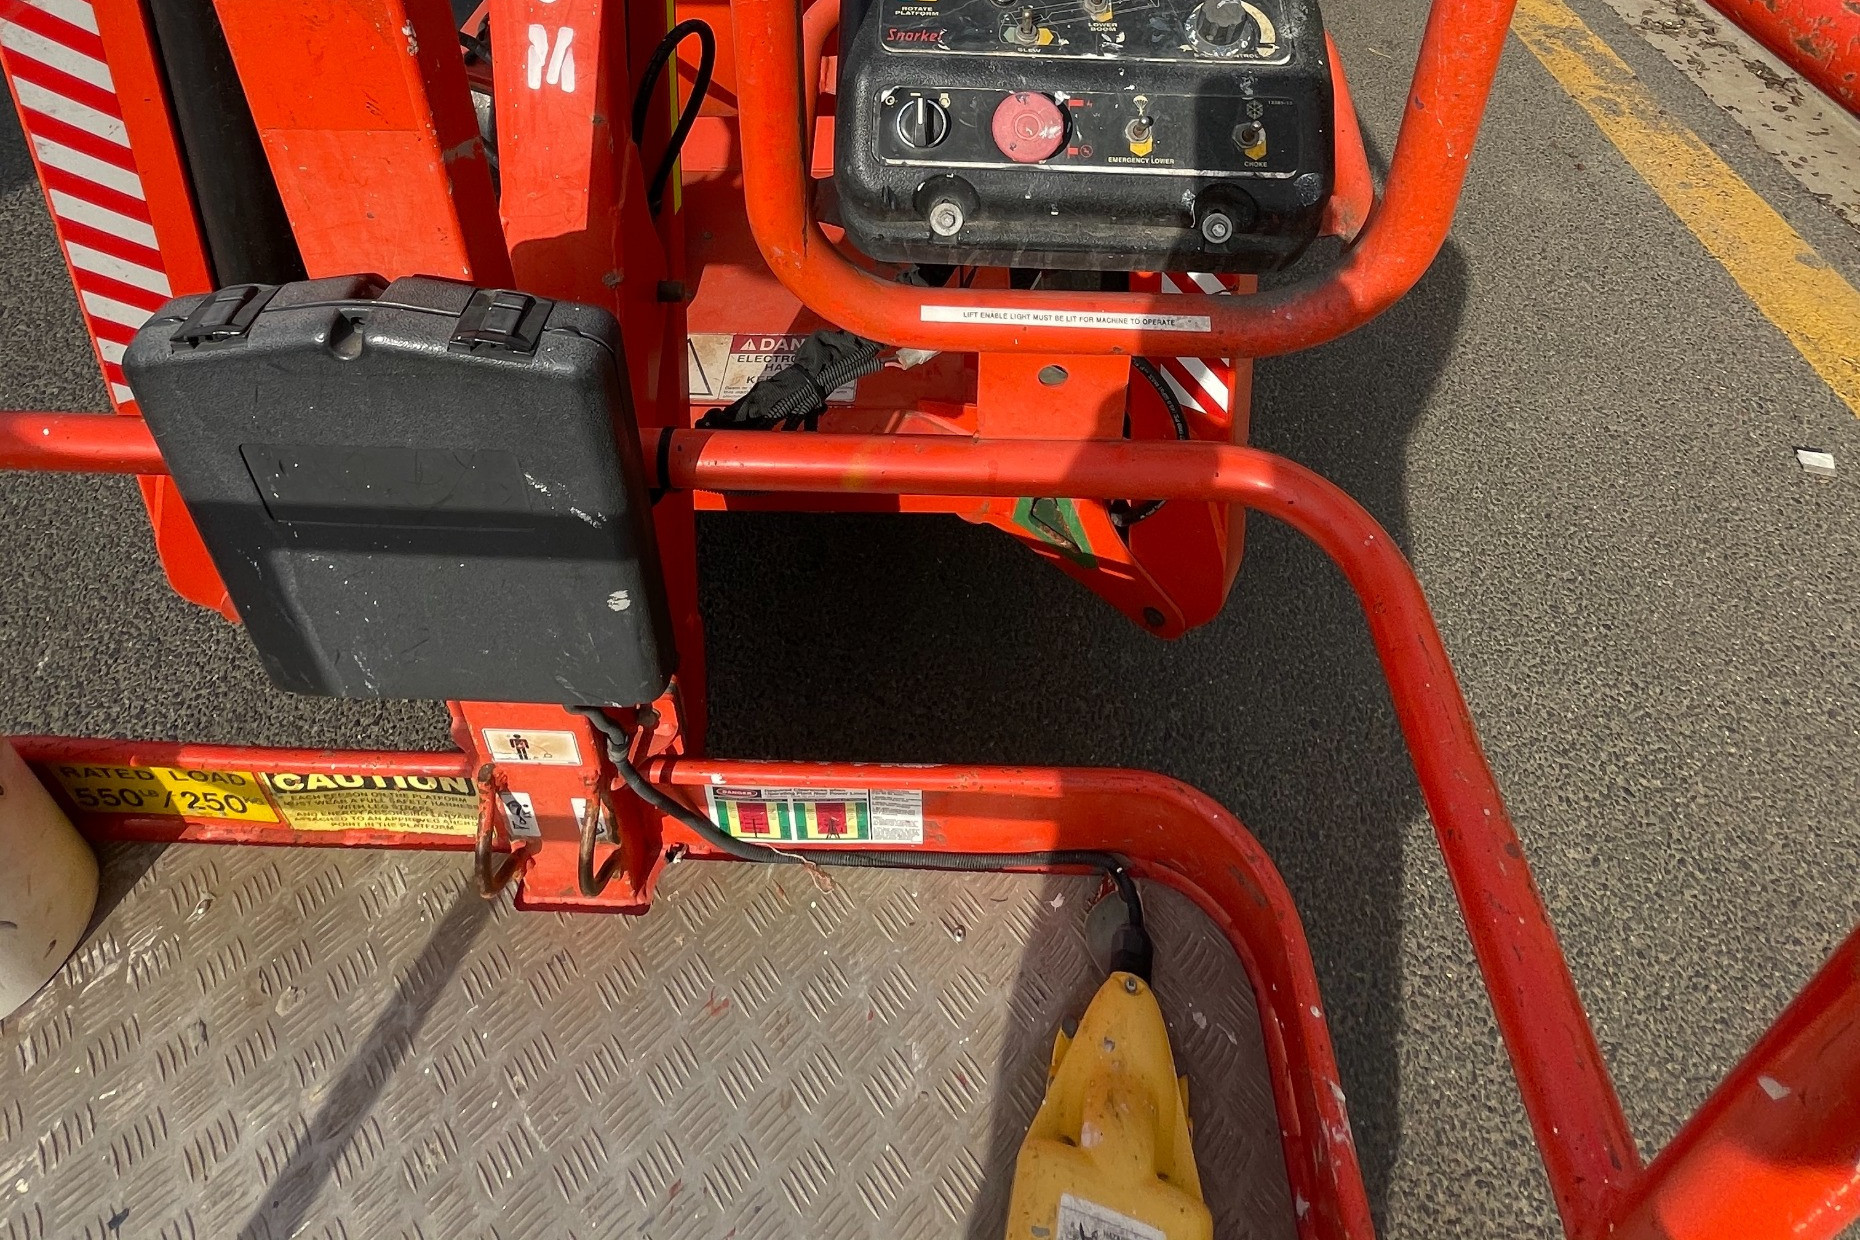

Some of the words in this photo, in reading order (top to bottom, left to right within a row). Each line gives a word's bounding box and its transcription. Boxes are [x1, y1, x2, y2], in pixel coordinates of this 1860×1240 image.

[1107, 156, 1150, 165] EMERGENCY
[1150, 157, 1175, 165] LOWER
[980, 312, 1008, 320] ENABLE
[1142, 318, 1176, 326] OPERATE
[759, 338, 806, 351] DAN
[59, 766, 155, 781] RATED
[168, 769, 247, 786] LOAD
[273, 774, 469, 793] CAUTION
[389, 798, 428, 806] SAFETY
[412, 793, 468, 803] PLATFORM
[399, 822, 455, 830] PLATFORM
